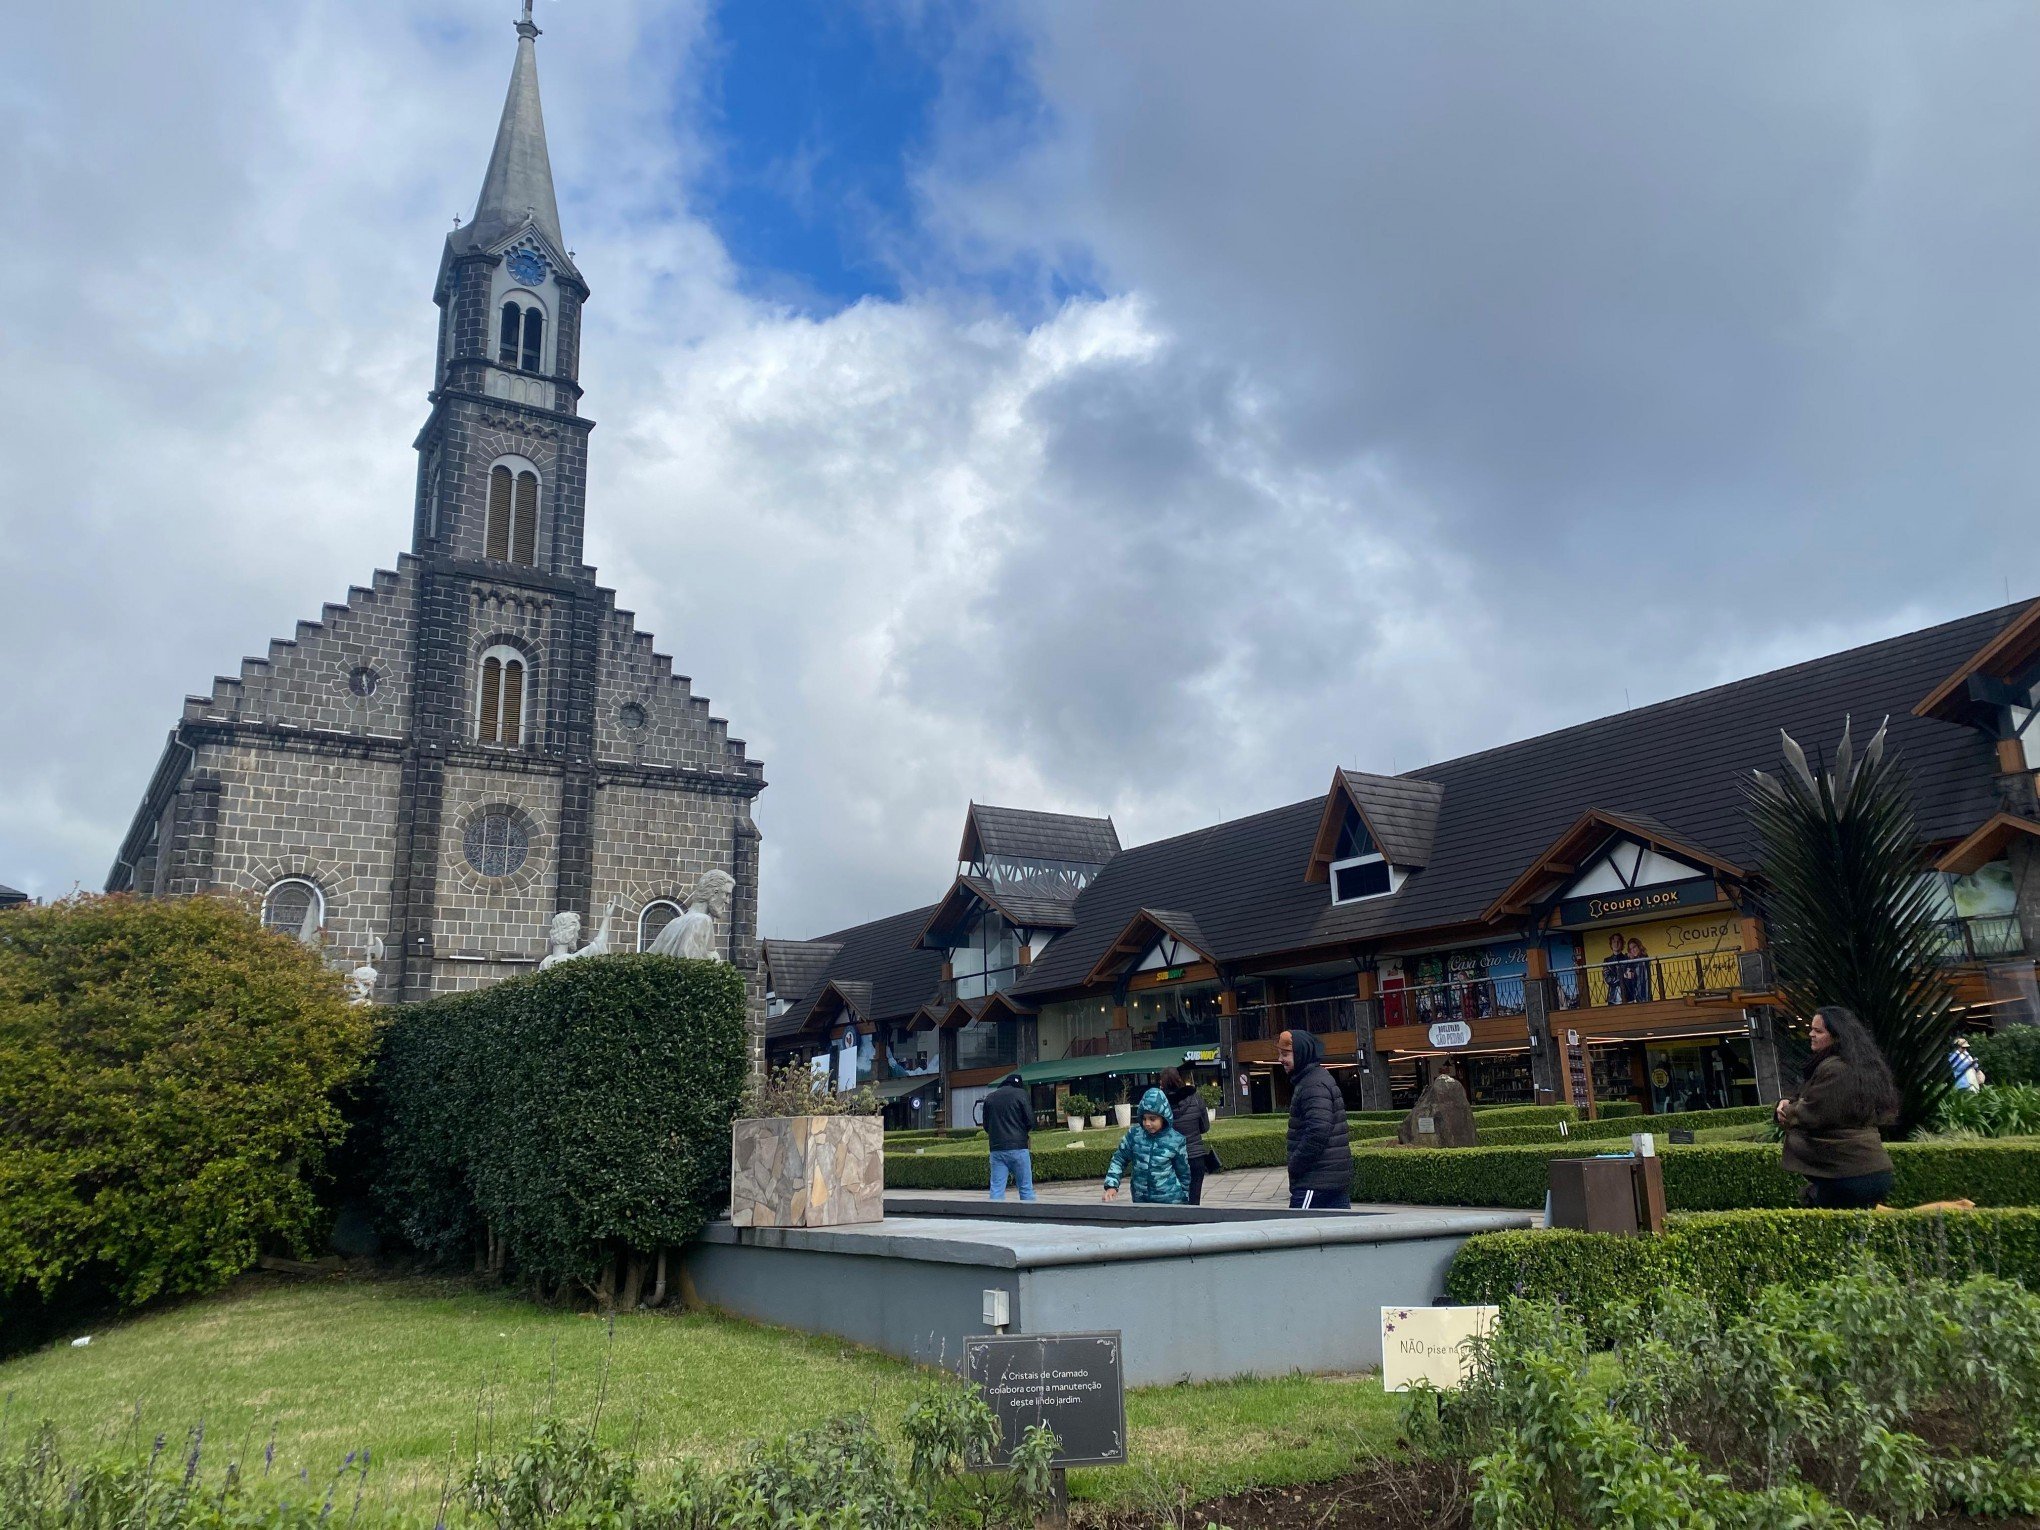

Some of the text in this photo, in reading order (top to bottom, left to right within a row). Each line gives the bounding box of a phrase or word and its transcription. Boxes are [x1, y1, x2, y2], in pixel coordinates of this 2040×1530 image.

[1603, 898, 1641, 911] COURO
[1646, 891, 1678, 904] LOOK
[1683, 924, 1728, 941] COURO
[1450, 955, 1476, 971] Casa
[1156, 968, 1184, 981] SUBWAY
[1447, 1032, 1464, 1045] PEDRO
[1184, 1050, 1217, 1061] SUBWAY
[1400, 1338, 1424, 1353] NÃO
[1427, 1345, 1446, 1357] pise
[1001, 1369, 1089, 1381] A Cristais de Gramado
[989, 1384, 1025, 1395] colabora
[1051, 1381, 1102, 1392] manutenção
[1010, 1395, 1083, 1407] deste lindo jardim.
